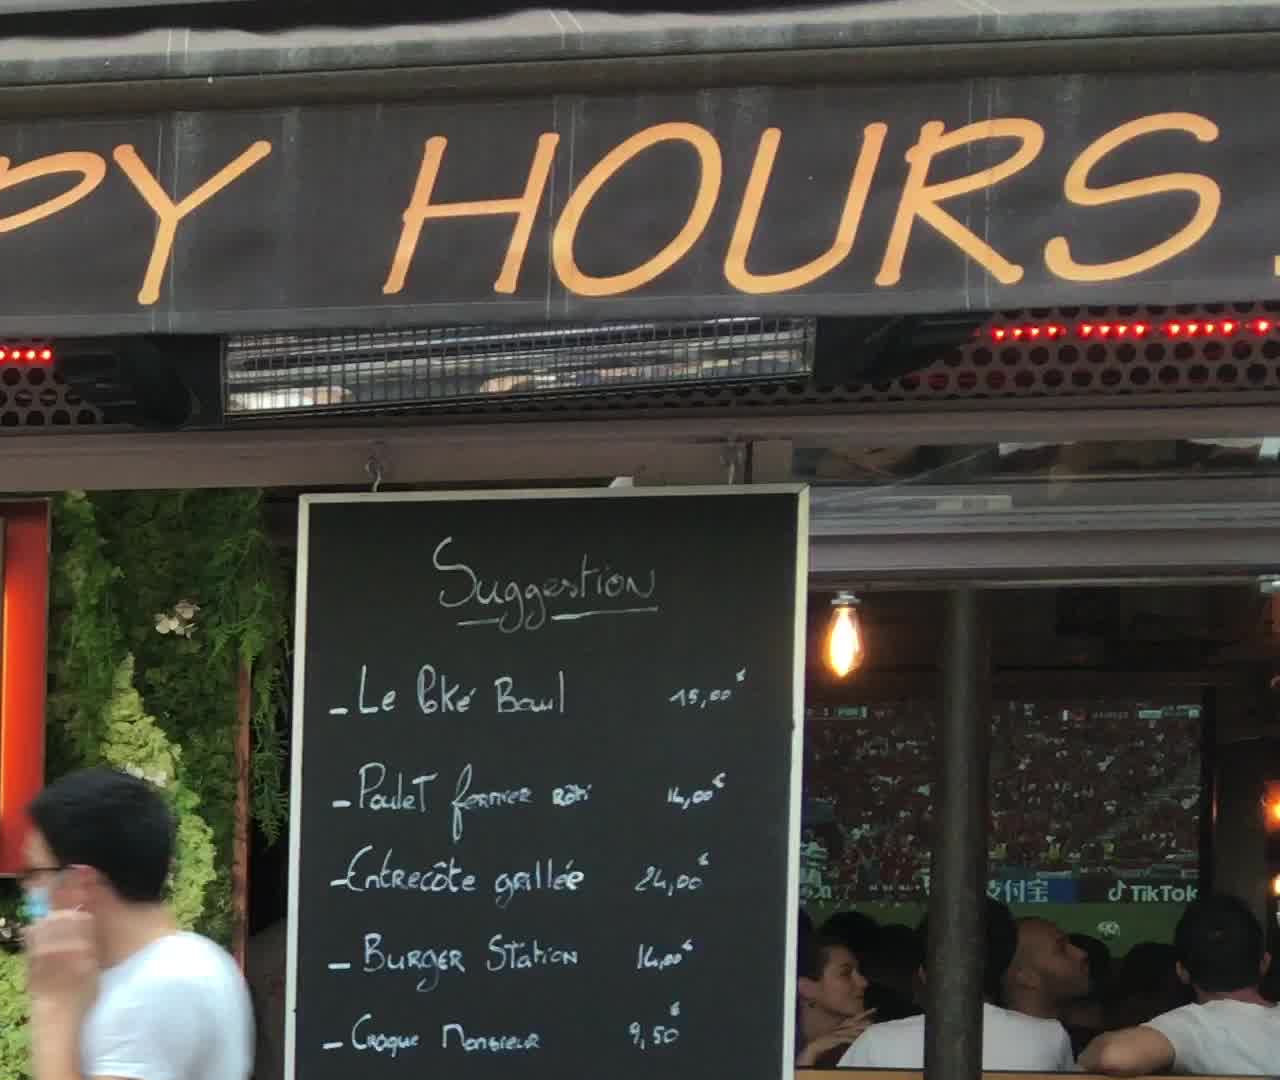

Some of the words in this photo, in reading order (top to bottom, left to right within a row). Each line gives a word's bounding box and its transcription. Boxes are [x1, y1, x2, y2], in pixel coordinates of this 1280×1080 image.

[383, 112, 1222, 296] HOURS
[433, 536, 656, 633] Suggestion
[358, 665, 396, 713] Le
[1128, 884, 1199, 902] TikTok
